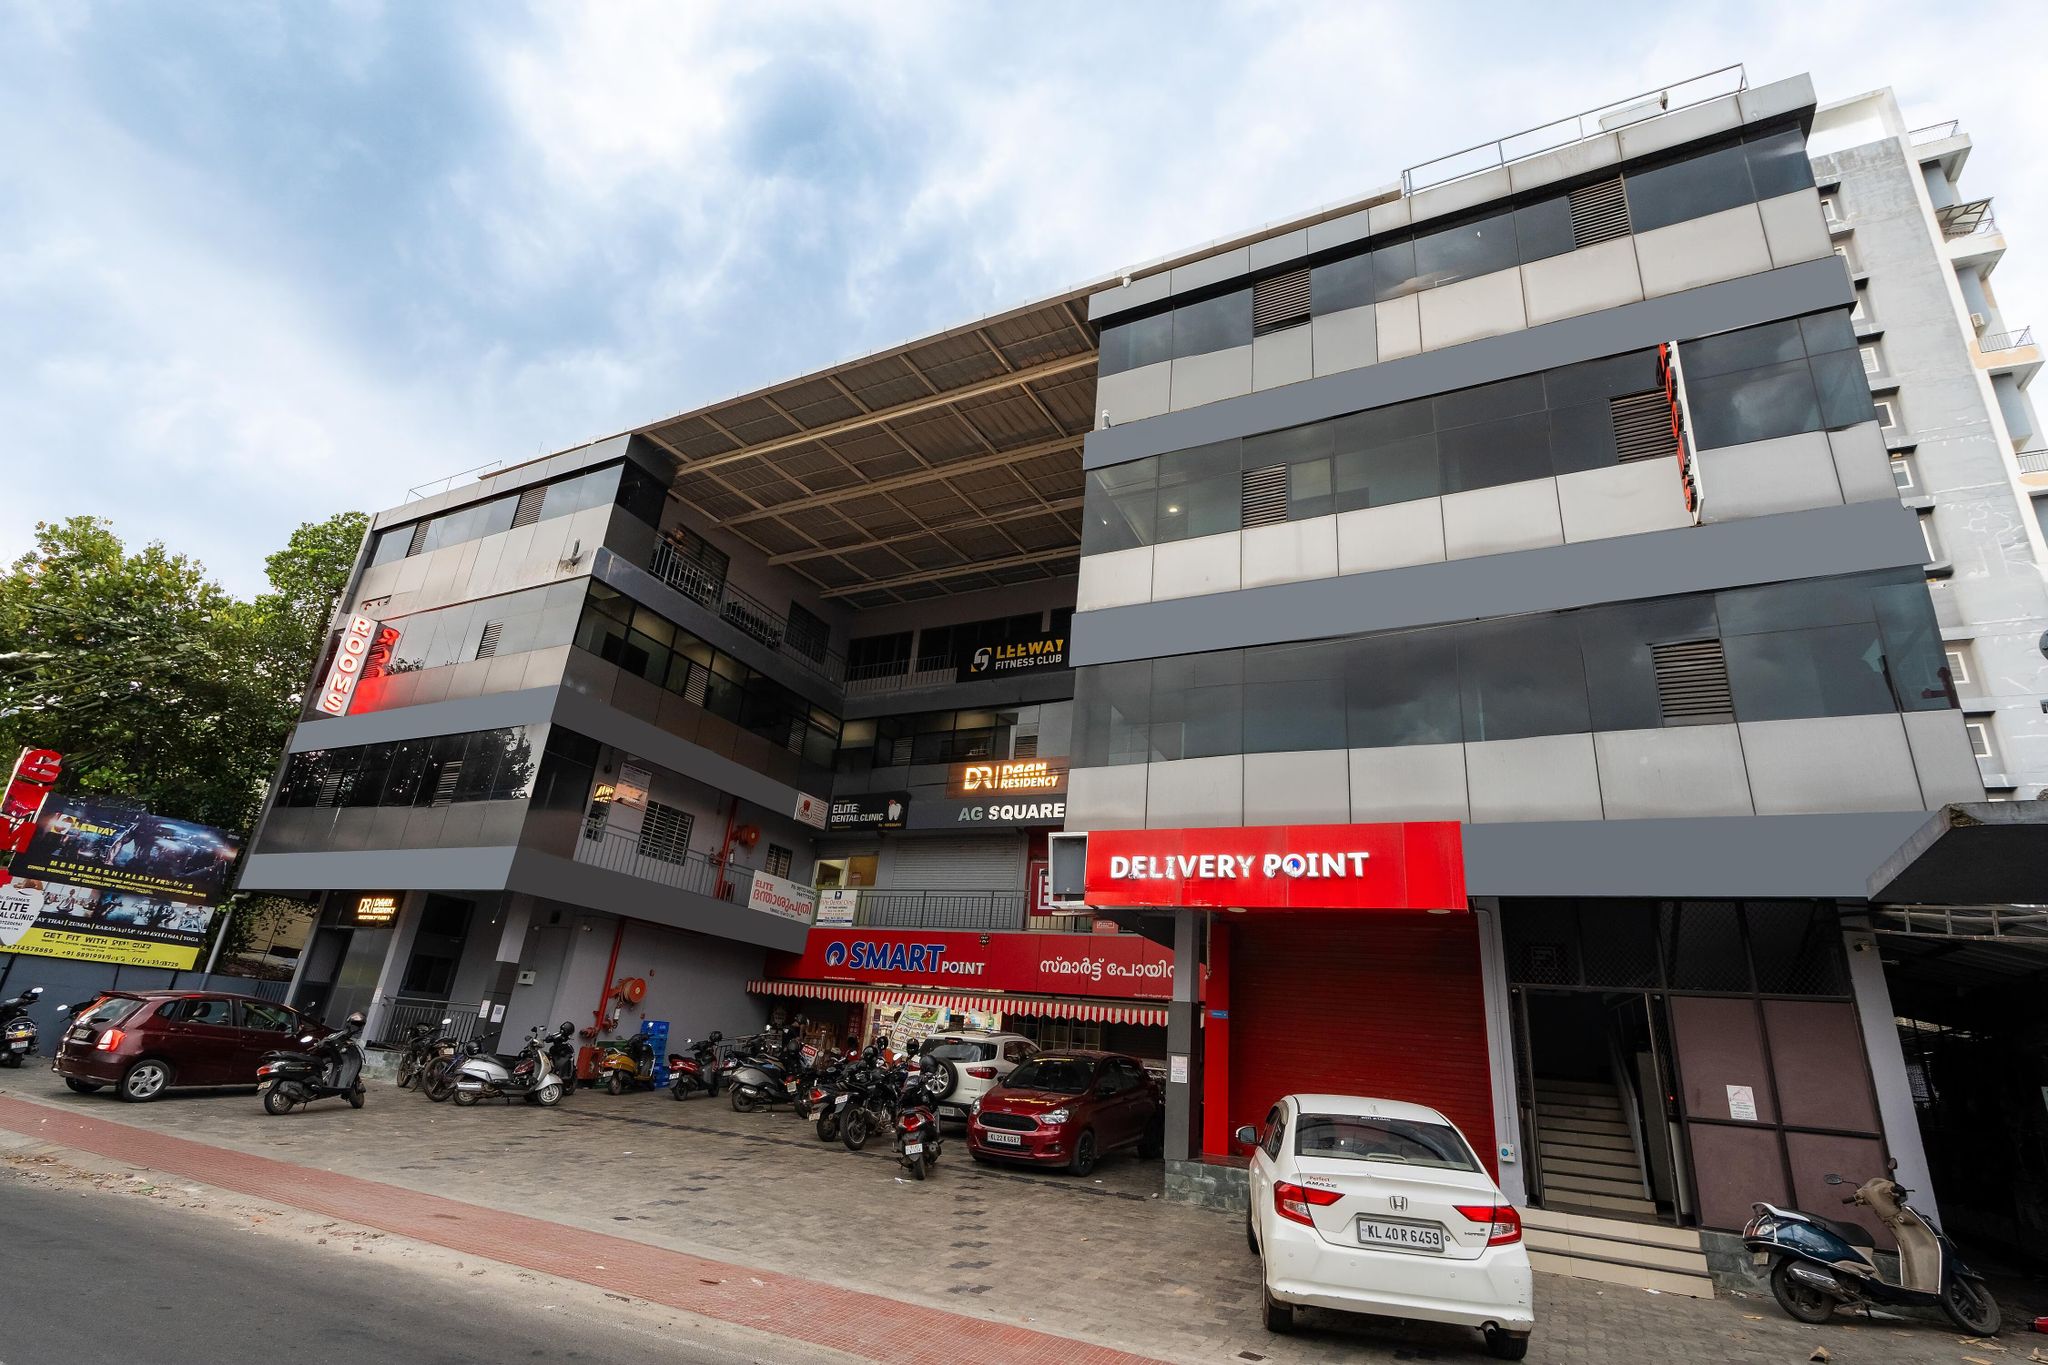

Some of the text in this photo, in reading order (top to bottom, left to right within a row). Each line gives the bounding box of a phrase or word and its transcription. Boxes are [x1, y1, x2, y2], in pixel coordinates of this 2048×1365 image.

[996, 639, 1064, 659] LEEWAY
[323, 616, 372, 713] ROOMS
[995, 654, 1062, 670] FITNESS CLUB
[964, 766, 993, 790] DR
[1000, 775, 1059, 789] RESIDENCY
[832, 803, 859, 814] ELITE
[958, 803, 1066, 821] AG SQUARE
[831, 813, 884, 823] DENTAL CLINIC
[1110, 852, 1370, 880] DELIVERY POINT
[755, 879, 775, 892] ELITE
[0, 901, 30, 913] LITE
[10, 912, 34, 921] CLINIC
[43, 931, 63, 940] GET
[66, 933, 82, 942] FIT
[85, 936, 108, 945] WITH
[848, 941, 985, 975] SMART POINT
[1305, 1180, 1337, 1188] AMAZE
[1367, 1225, 1440, 1245] KL 40 R 6459
